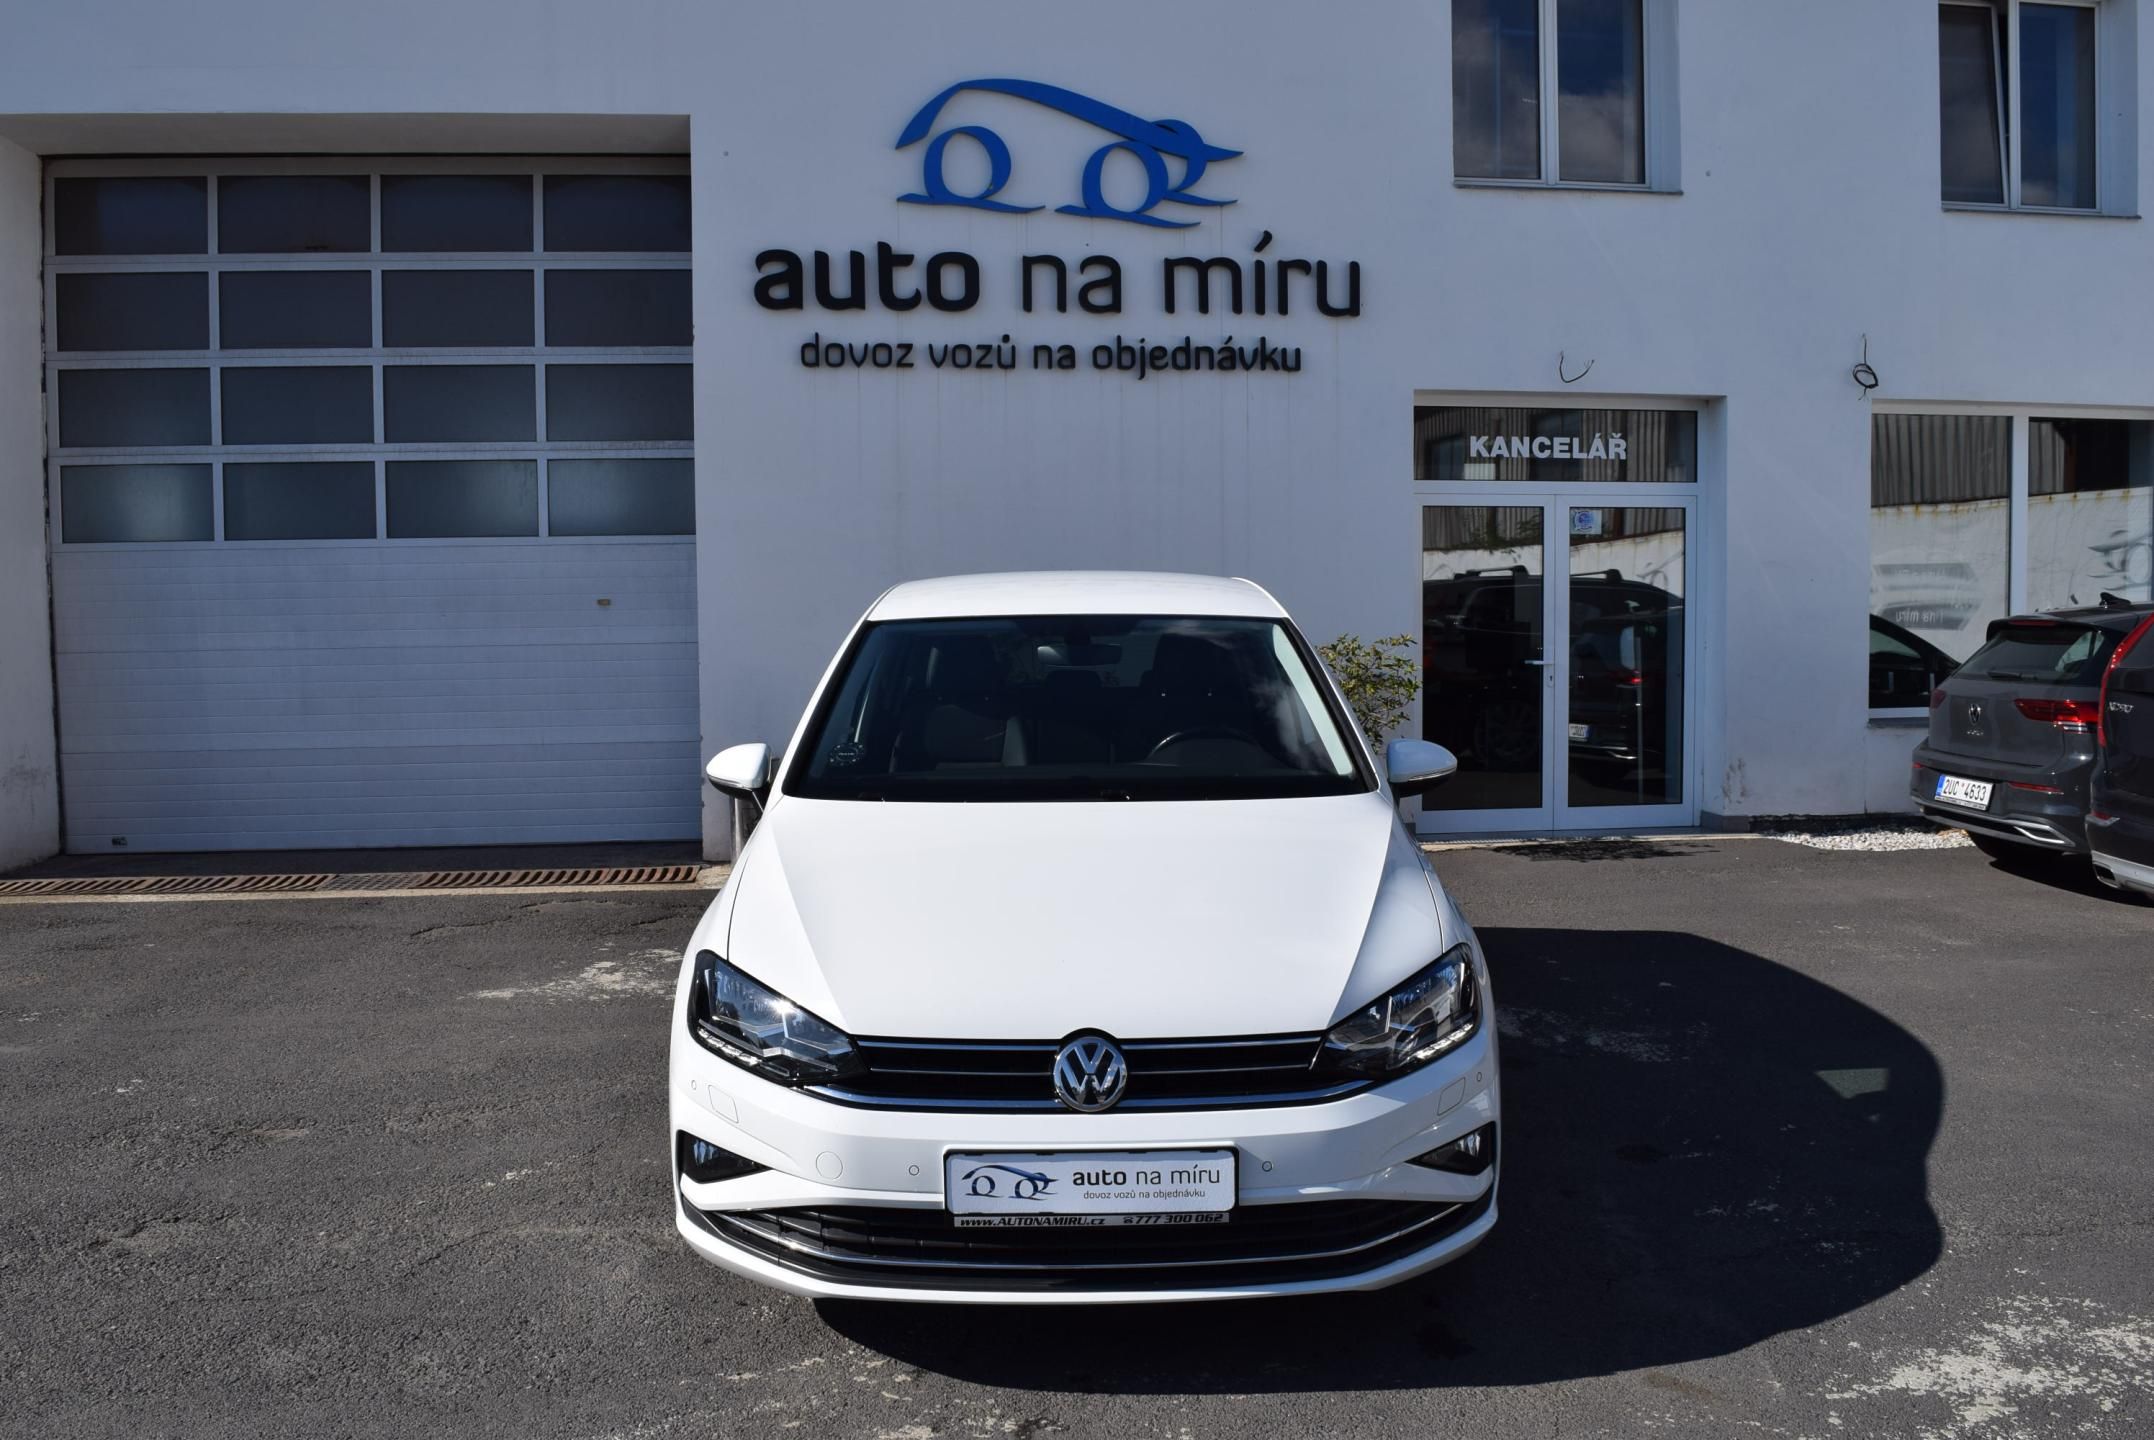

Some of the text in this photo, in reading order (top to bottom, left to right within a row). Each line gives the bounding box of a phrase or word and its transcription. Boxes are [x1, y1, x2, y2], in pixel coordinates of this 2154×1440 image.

[754, 230, 1361, 318] auto na míru
[800, 333, 1301, 380] dovoz vozů na objednávku
[1469, 432, 1627, 460] KANCELÁŘ
[1943, 778, 1987, 801] 2UC 4633
[1072, 1164, 1220, 1186] auto na míru
[1083, 1188, 1206, 1200] dovoz vozů na objednávku
[1135, 1215, 1161, 1225] 777
[1163, 1214, 1193, 1225] 300
[1195, 1213, 1224, 1223] 062
